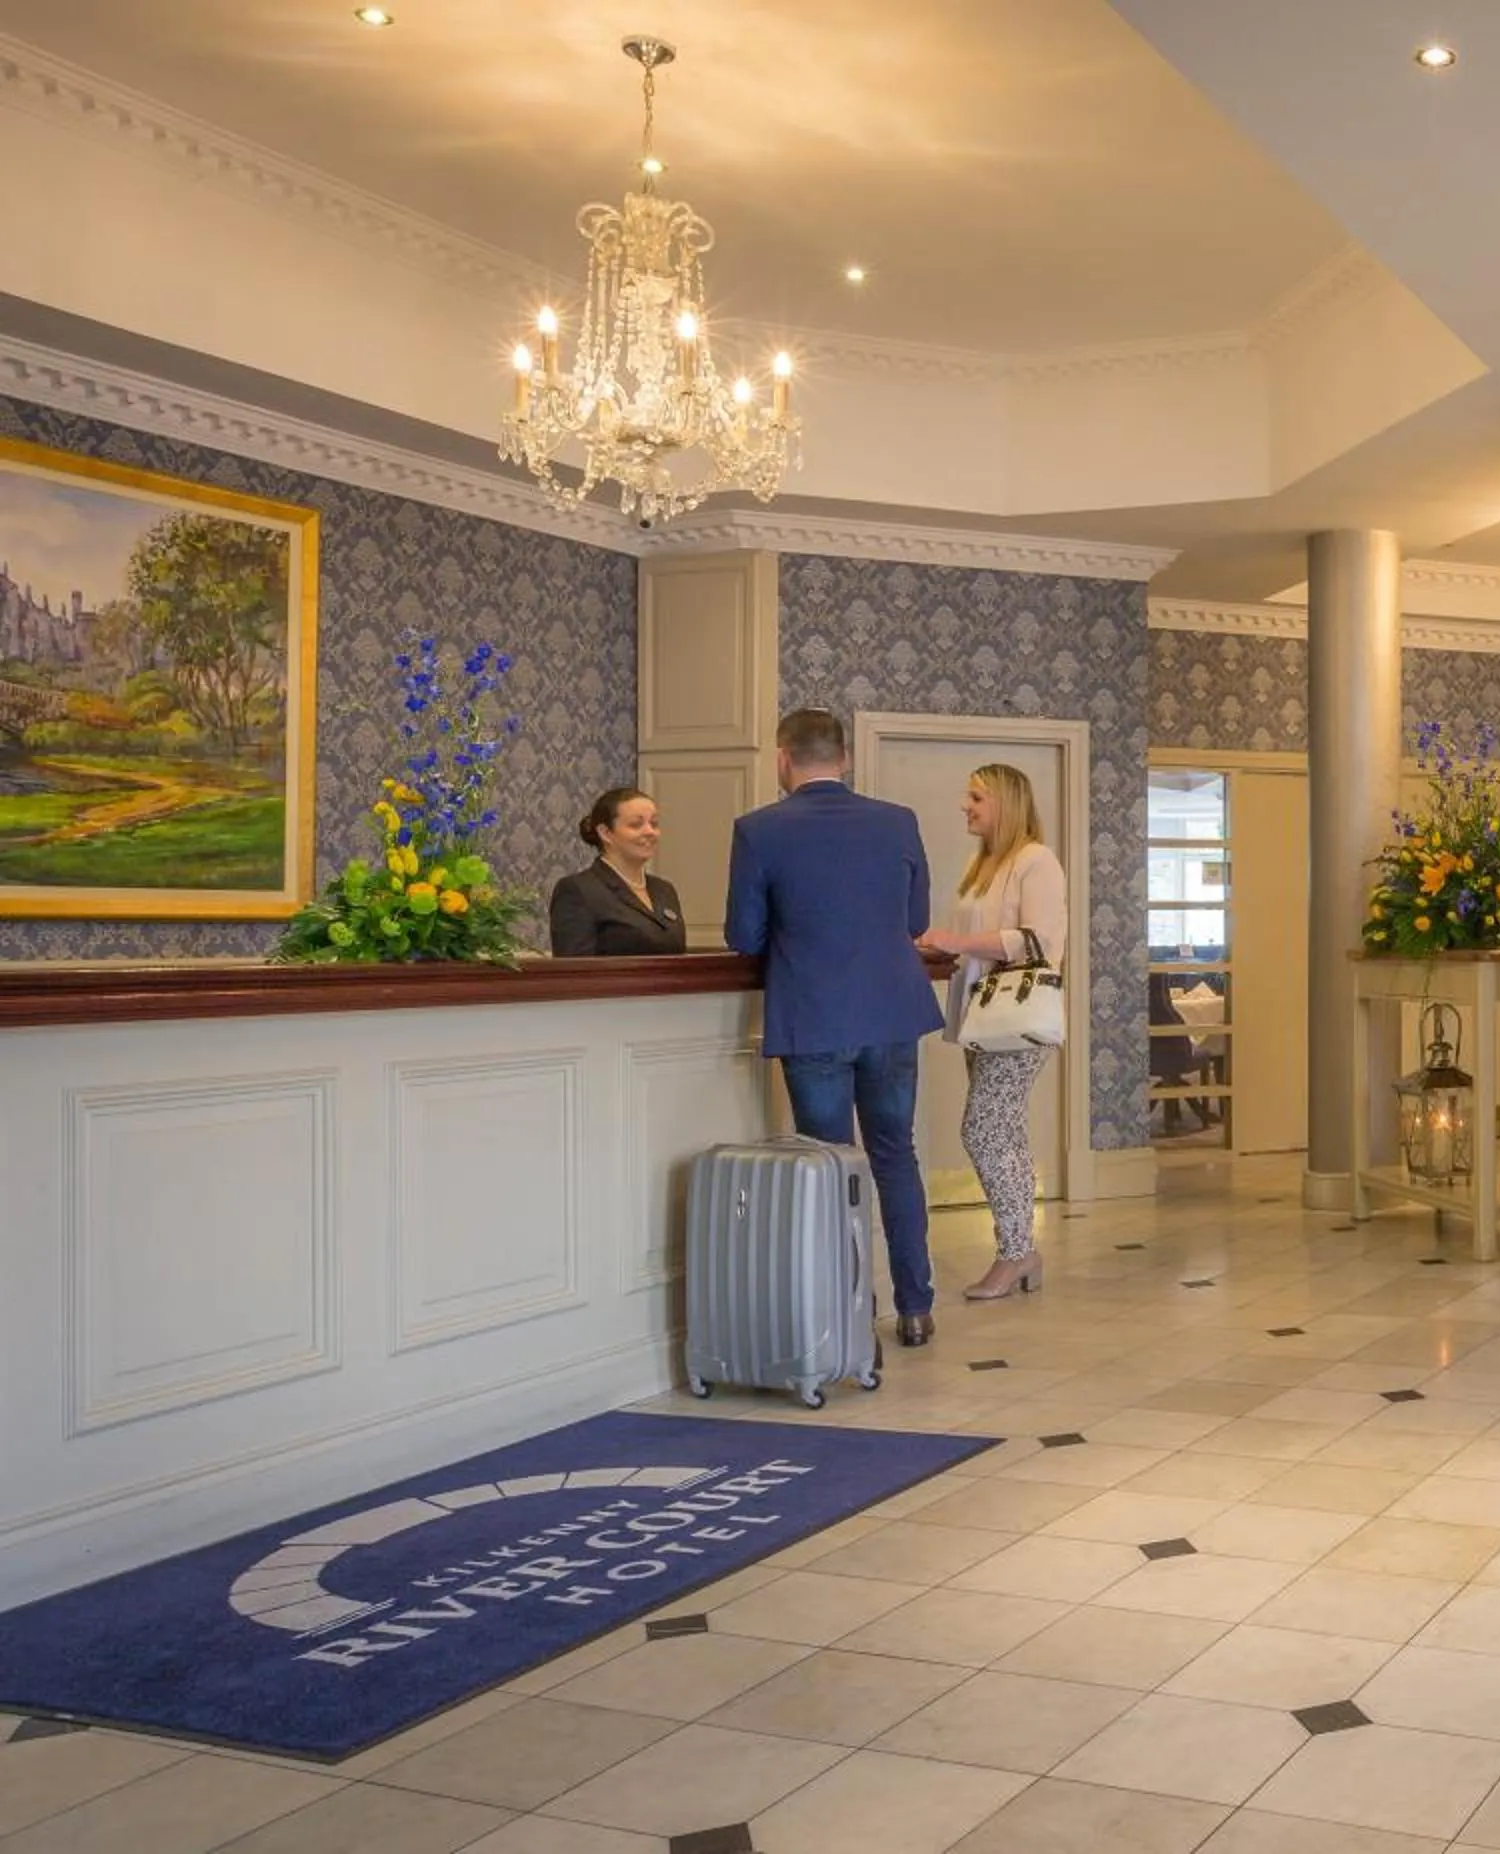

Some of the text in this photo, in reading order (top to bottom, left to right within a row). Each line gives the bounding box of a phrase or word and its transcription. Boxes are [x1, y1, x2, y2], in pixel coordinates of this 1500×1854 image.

[291, 1459, 816, 1668] RIVER COURT
[409, 1499, 639, 1588] KILKENNY
[544, 1514, 782, 1605] HOTEL
